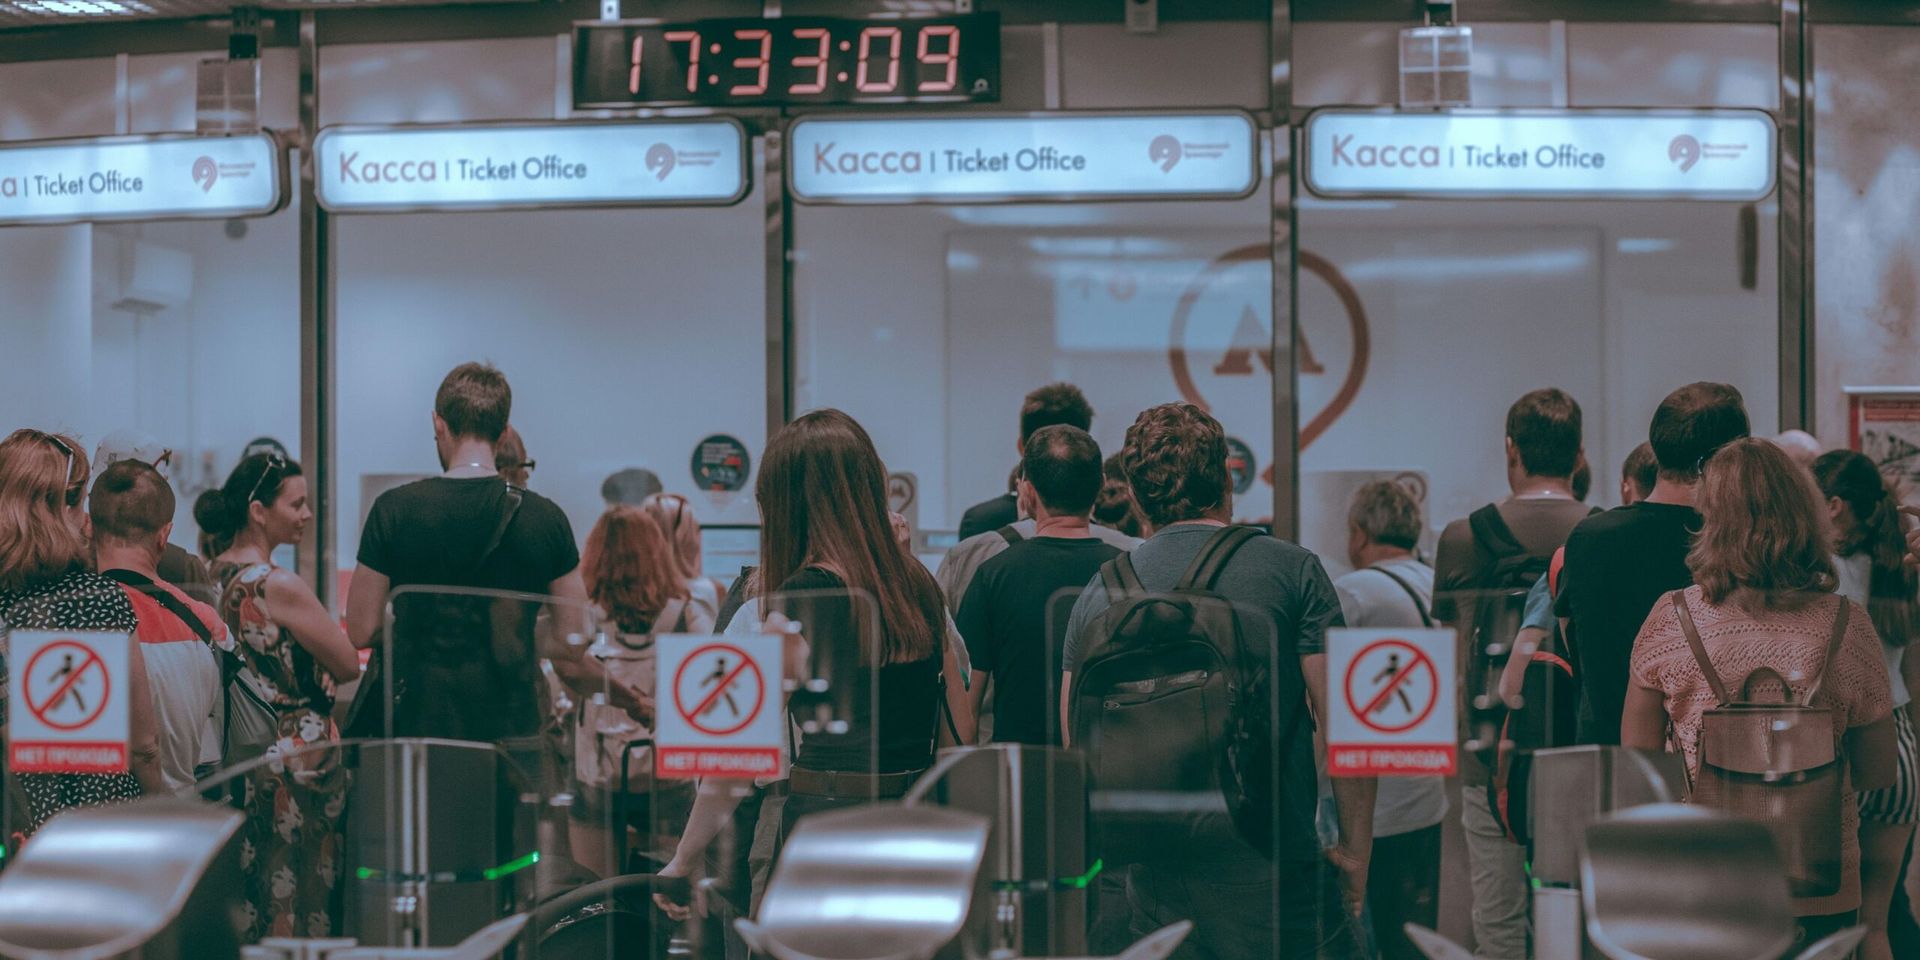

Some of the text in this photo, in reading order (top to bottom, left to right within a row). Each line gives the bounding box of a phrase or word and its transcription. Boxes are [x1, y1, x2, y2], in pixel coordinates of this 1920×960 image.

[629, 25, 961, 96] 17:33:09
[814, 142, 922, 174] Касса
[944, 146, 1086, 173] Ticket Office
[1331, 134, 1440, 168] Касса
[1464, 144, 1606, 169] Ticket Office
[339, 151, 437, 184] Касса
[457, 155, 588, 181] Ticket Office
[34, 172, 84, 196] Ticket
[88, 169, 143, 194] Office
